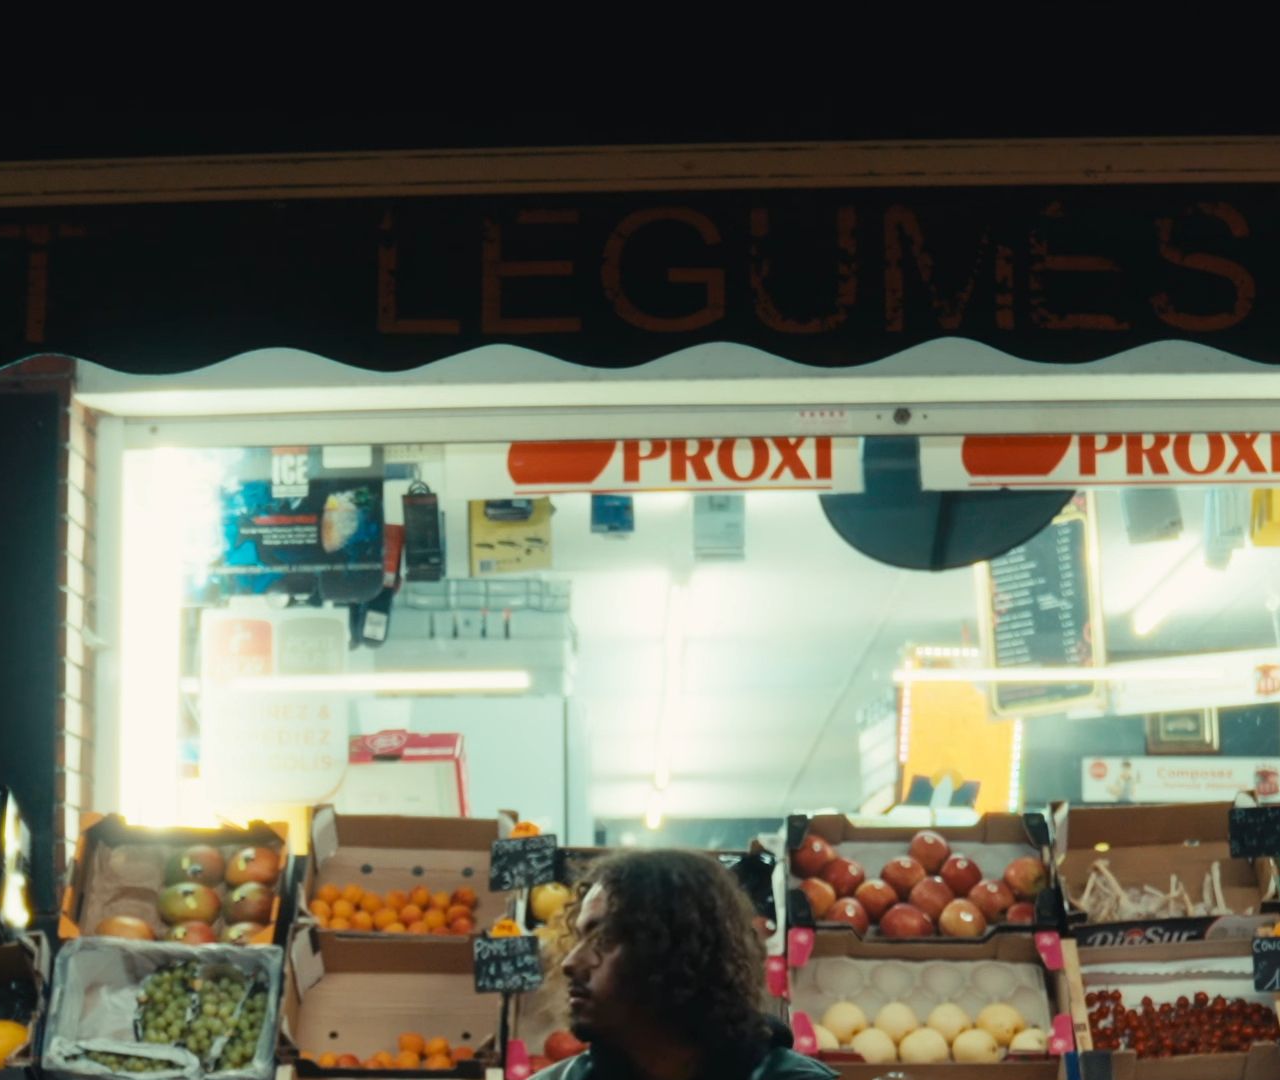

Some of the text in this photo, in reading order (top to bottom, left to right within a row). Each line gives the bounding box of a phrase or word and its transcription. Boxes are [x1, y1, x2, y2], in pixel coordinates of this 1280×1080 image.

[376, 199, 1256, 337] LEGUMES
[271, 453, 309, 486] ICE
[622, 436, 833, 483] PROXI
